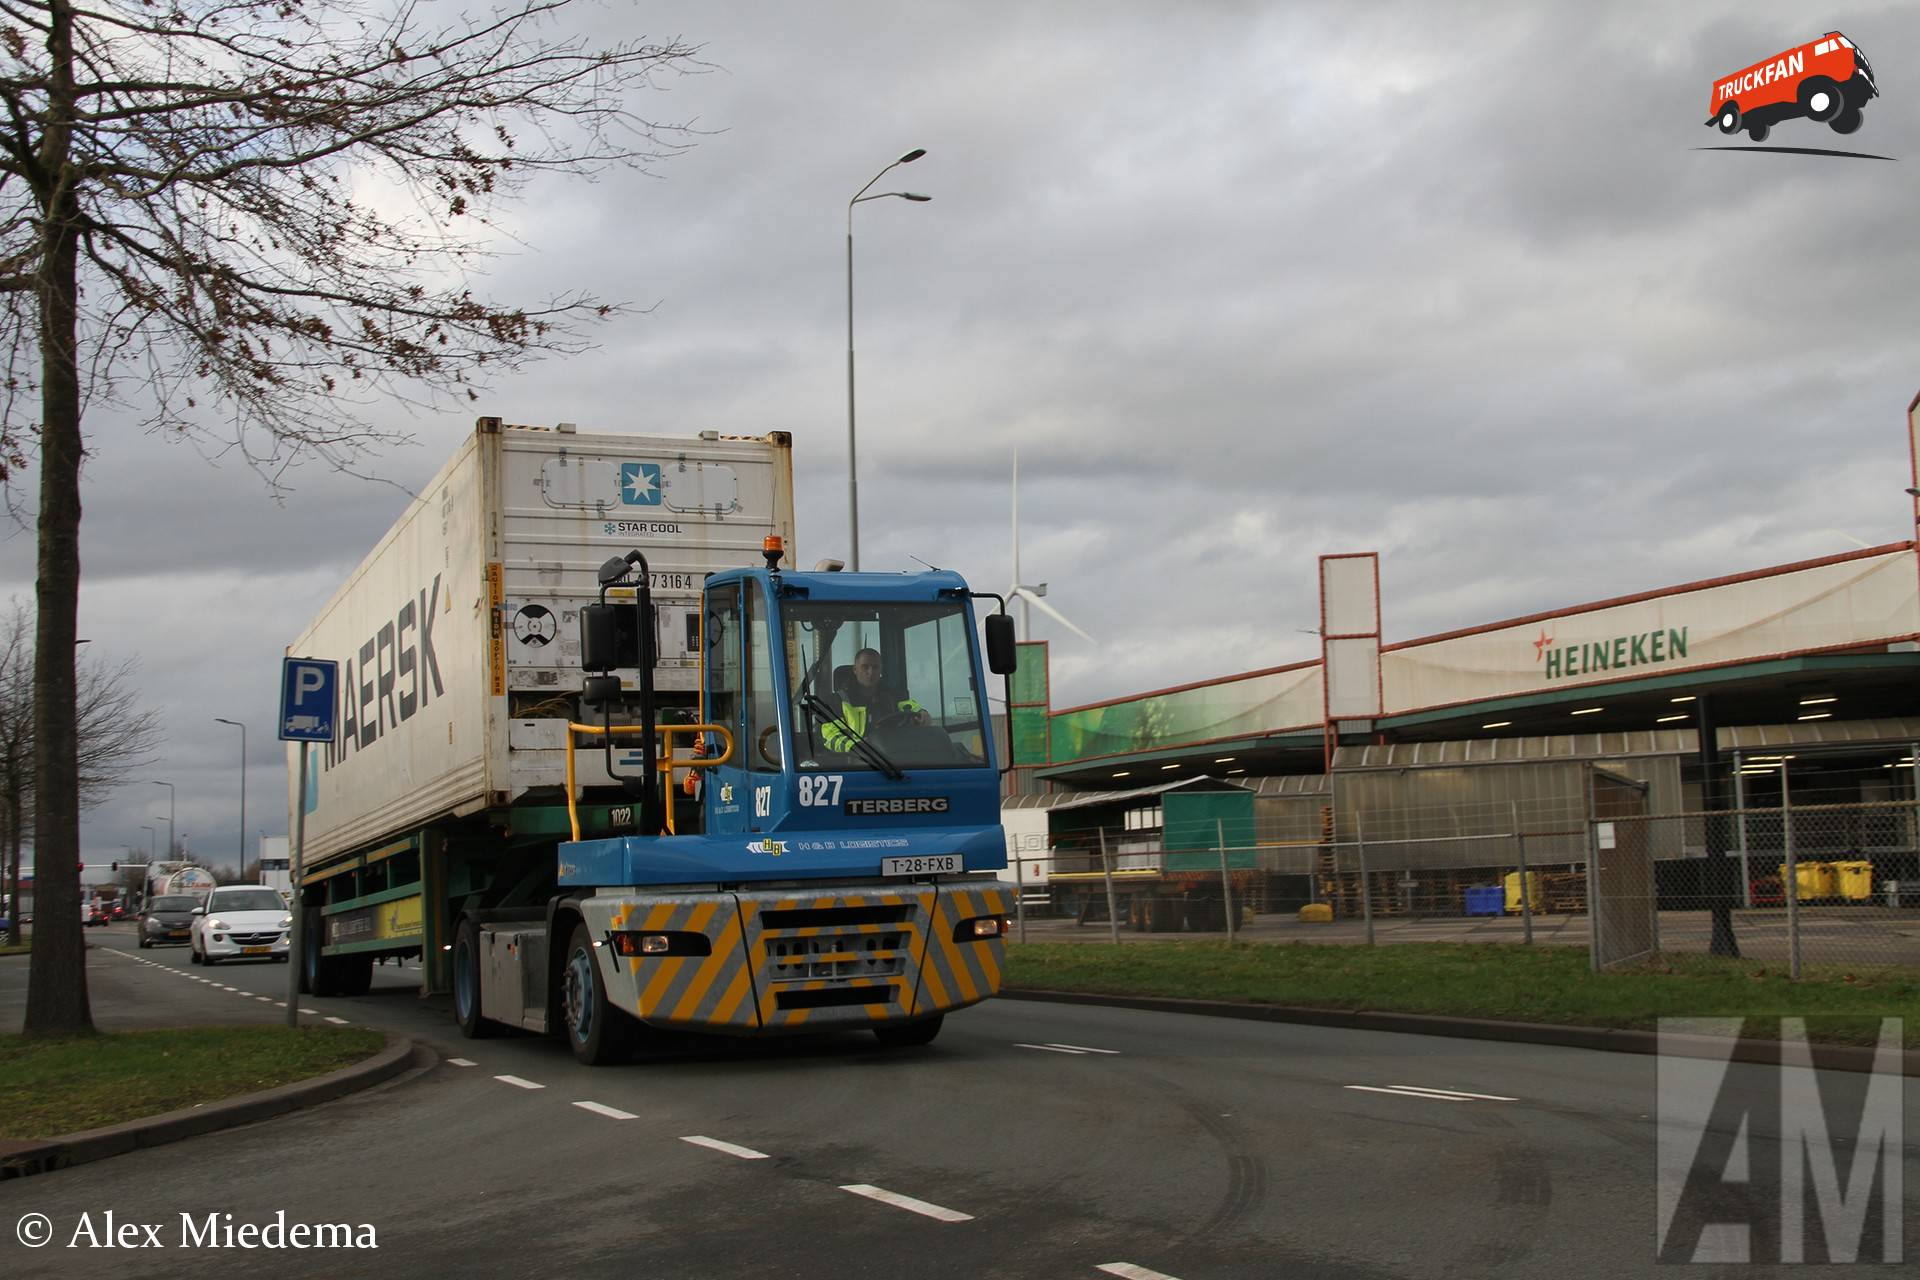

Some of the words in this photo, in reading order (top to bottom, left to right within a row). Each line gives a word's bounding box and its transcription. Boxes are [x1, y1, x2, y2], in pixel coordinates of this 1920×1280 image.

[618, 522, 647, 532] STAR
[650, 523, 682, 533] COOL
[1546, 626, 1688, 680] HEINEKEN
[294, 666, 326, 706] P
[755, 786, 771, 818] 827
[799, 775, 844, 807] 827
[611, 807, 632, 827] 1022
[847, 798, 949, 814] TERBERG
[891, 858, 954, 873] T-28-FXB
